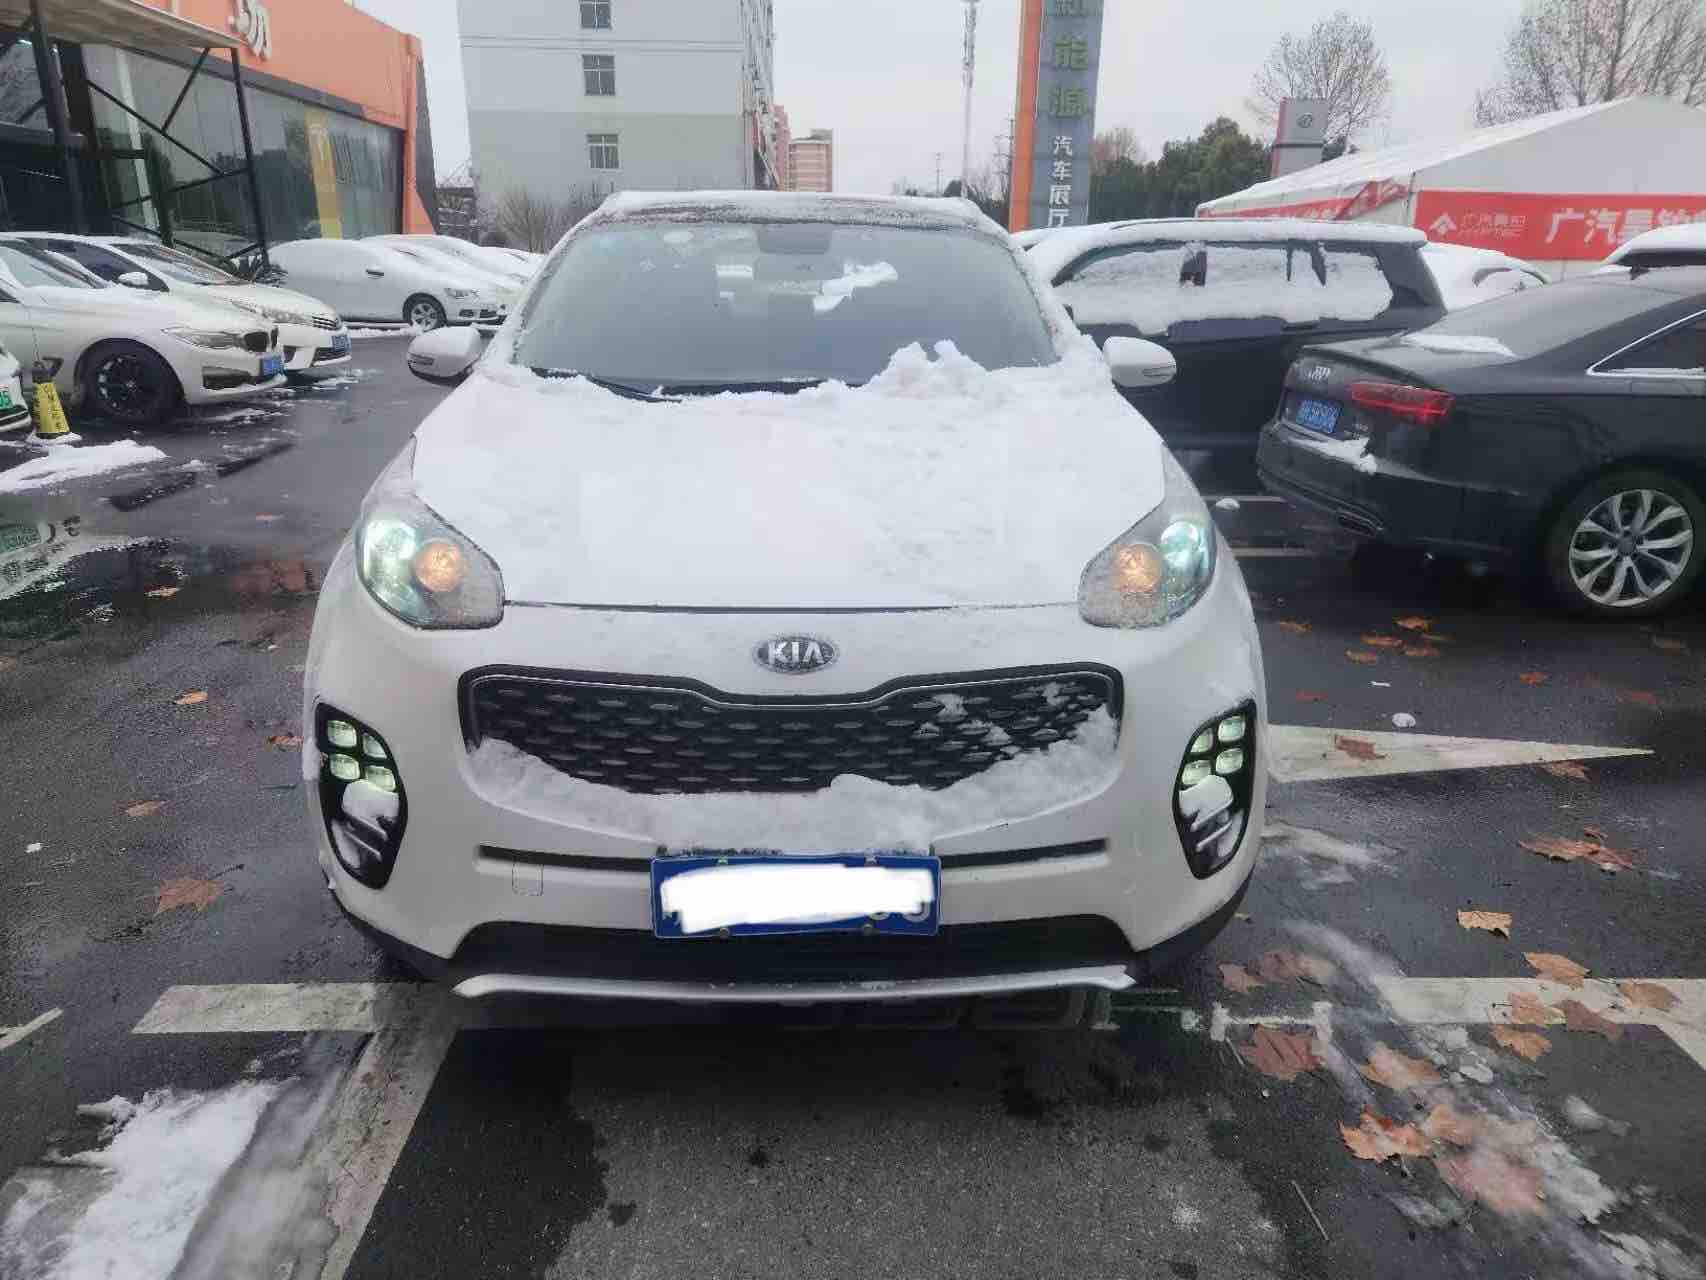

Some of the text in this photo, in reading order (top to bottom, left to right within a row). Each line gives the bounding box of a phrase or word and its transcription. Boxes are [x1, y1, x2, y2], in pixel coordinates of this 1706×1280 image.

[1048, 135, 1073, 228] 汽车展厅
[767, 640, 825, 664] KIA
